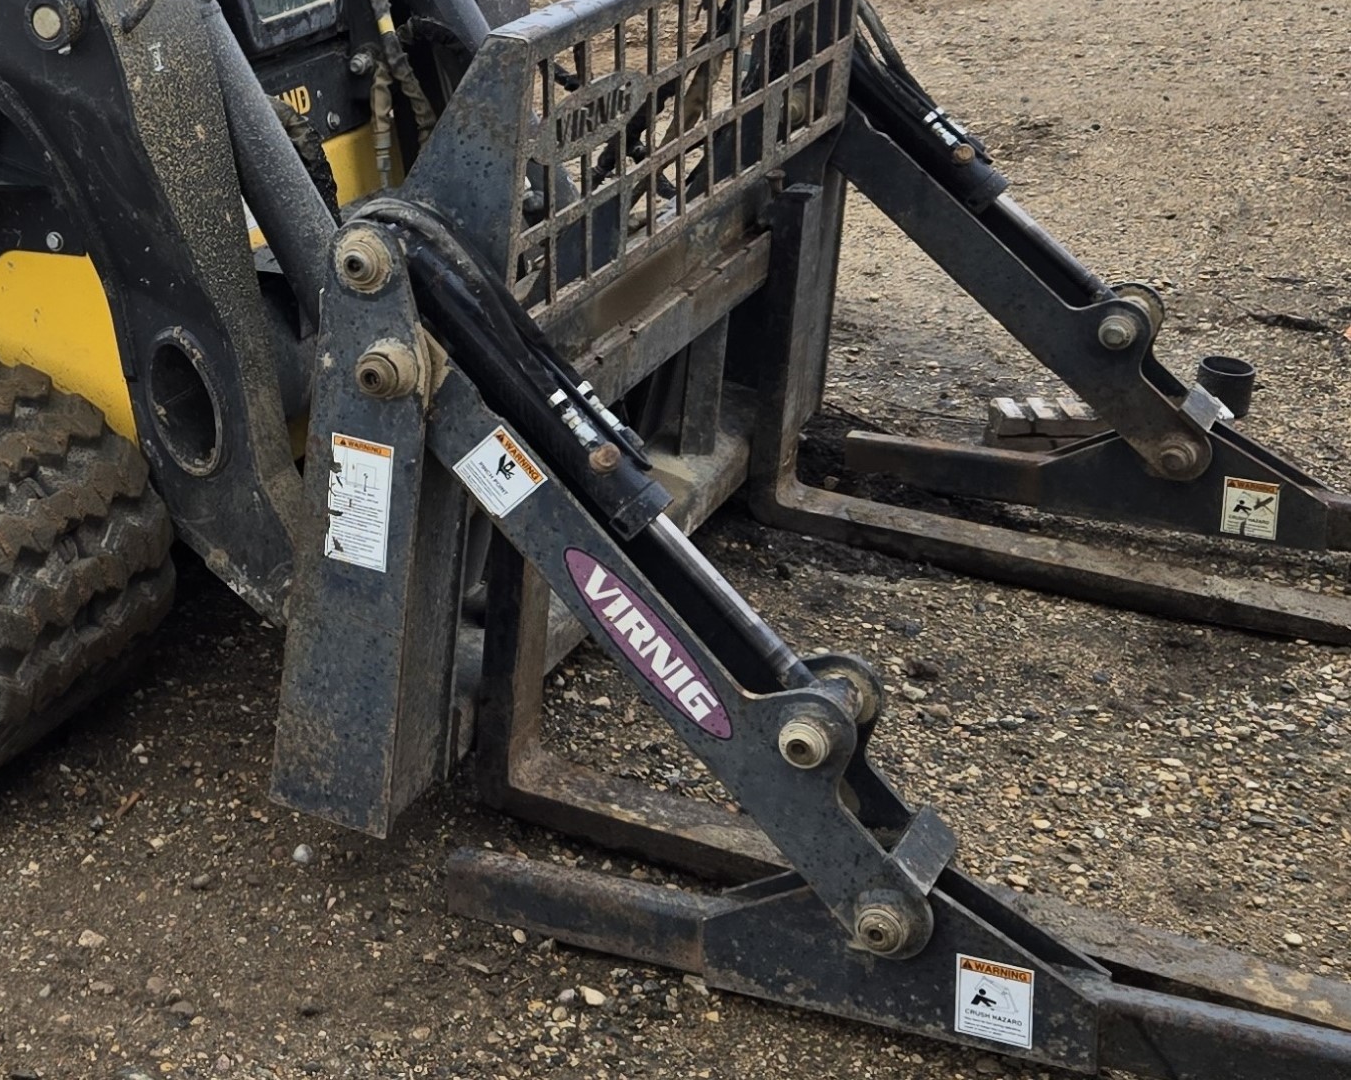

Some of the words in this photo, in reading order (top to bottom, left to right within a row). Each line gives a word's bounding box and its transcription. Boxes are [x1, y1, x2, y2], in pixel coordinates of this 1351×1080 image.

[505, 441, 540, 480] WARNING
[584, 564, 719, 722] VIRNIG
[975, 962, 1028, 981] WARNING
[964, 1007, 990, 1019] CRUSH
[992, 1015, 1023, 1027] HAZARD
